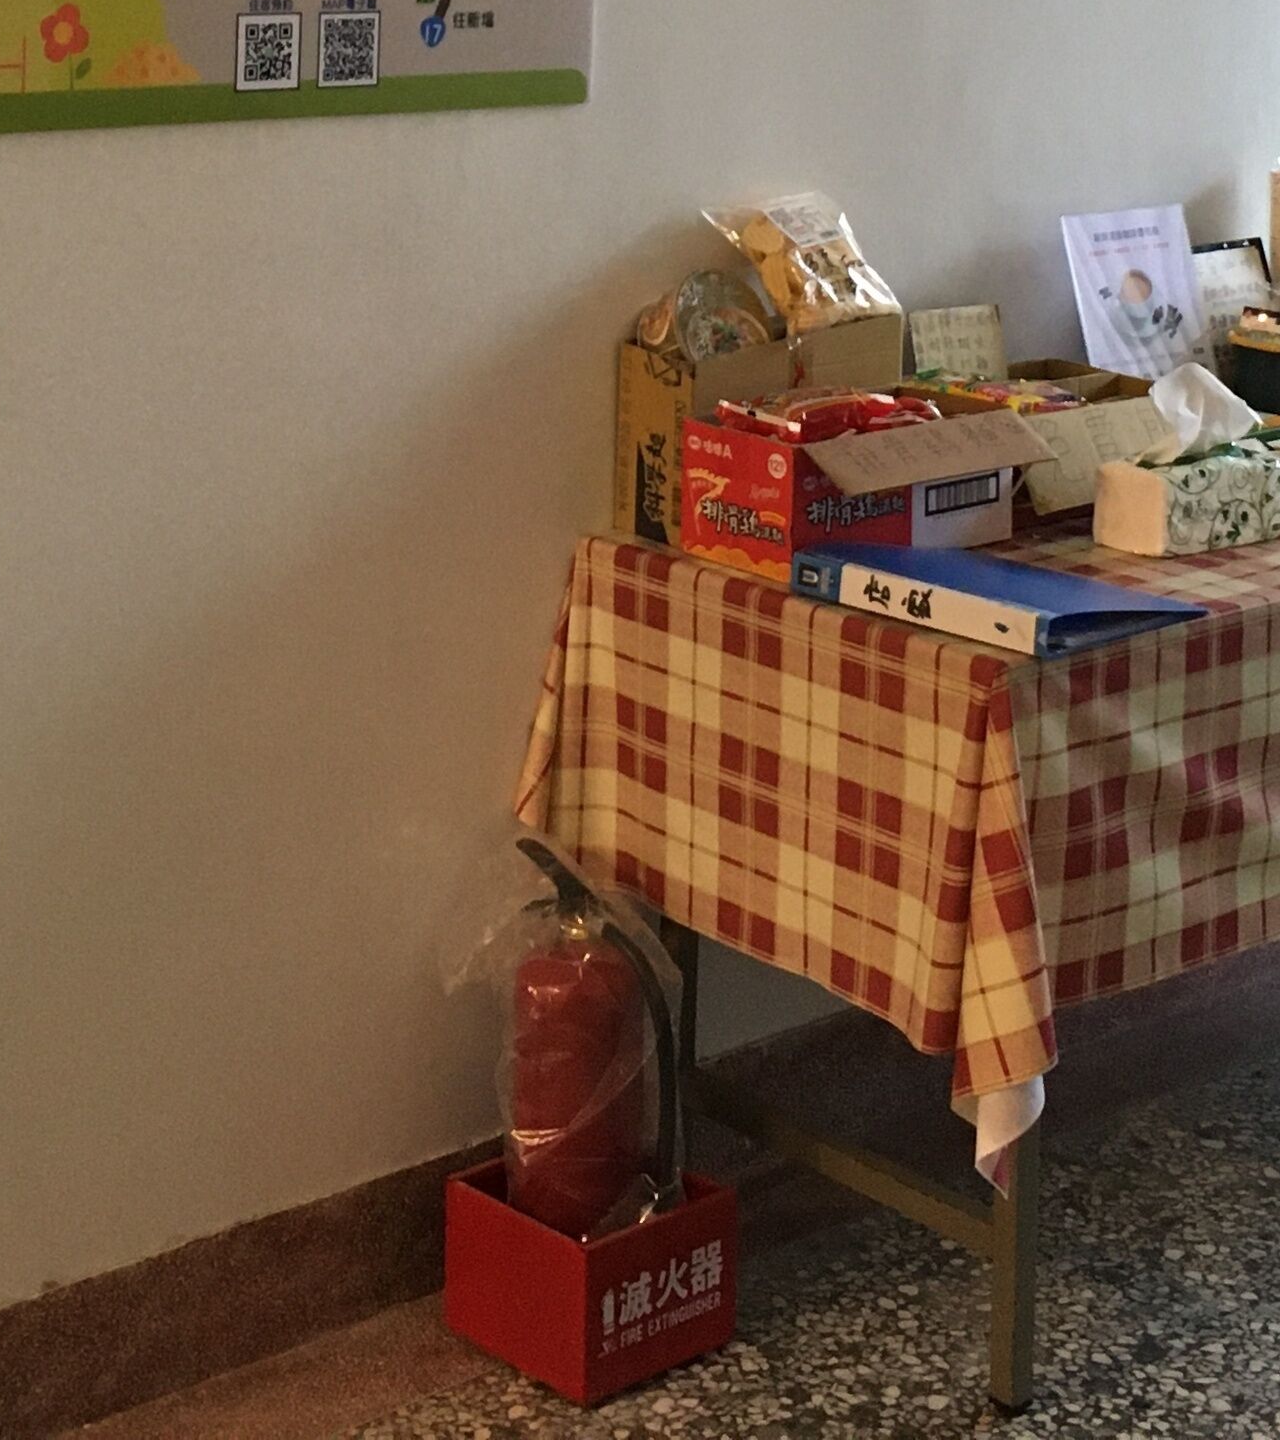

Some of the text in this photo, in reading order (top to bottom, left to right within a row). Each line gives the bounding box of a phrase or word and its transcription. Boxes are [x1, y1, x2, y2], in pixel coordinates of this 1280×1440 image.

[422, 22, 443, 43] 17
[619, 1239, 723, 1326] 滅火器
